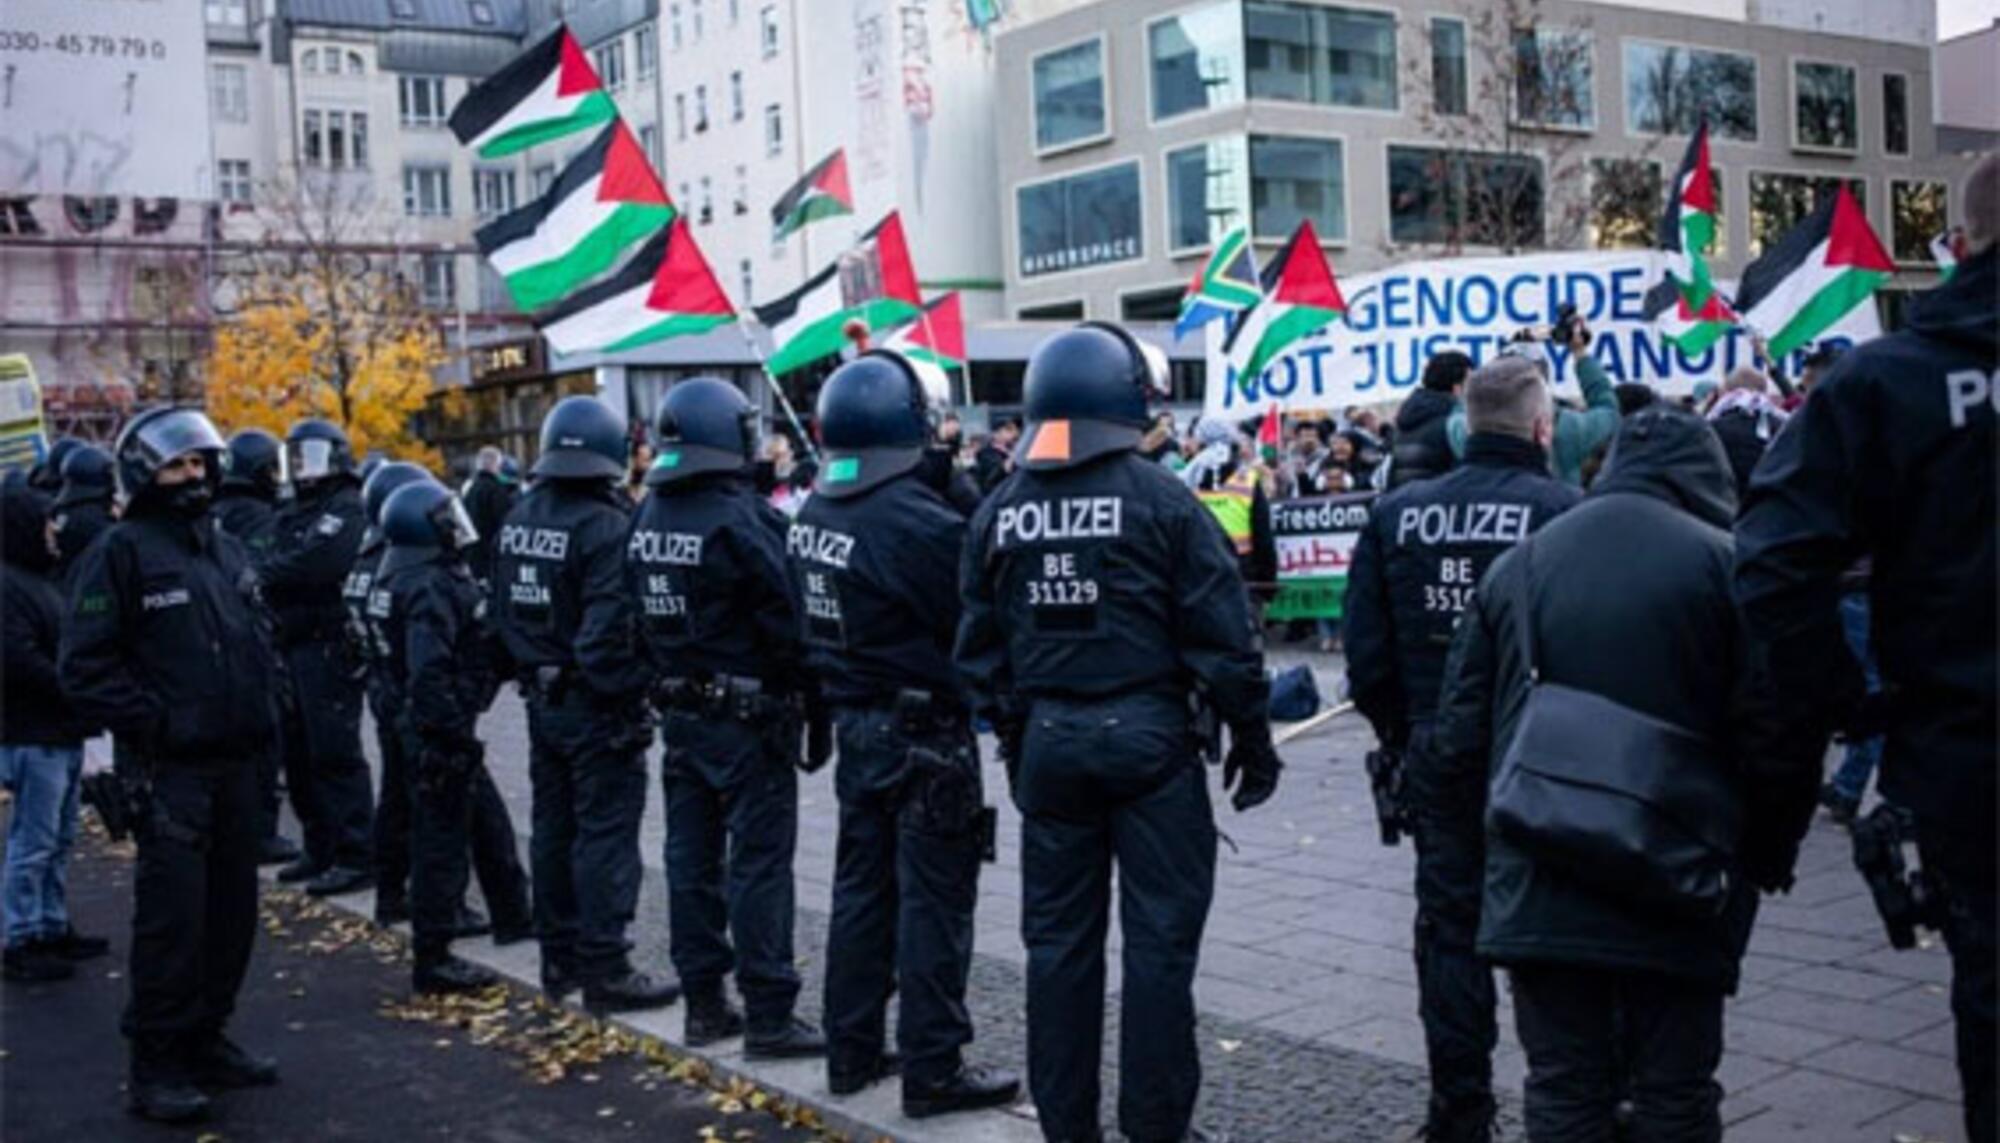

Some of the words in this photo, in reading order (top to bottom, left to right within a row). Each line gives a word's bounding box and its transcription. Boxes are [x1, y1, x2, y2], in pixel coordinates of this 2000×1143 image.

[1343, 269, 1643, 332] GENOCIDE
[997, 496, 1123, 547] POLIZEI
[1269, 501, 1368, 532] Freedom
[1396, 503, 1532, 545] POLIZEI
[500, 524, 568, 560] POLIZEI
[629, 530, 703, 566] POLIZEI
[786, 525, 855, 569] POLIZEI
[1043, 553, 1077, 578] BE
[1440, 557, 1473, 584] BE
[648, 574, 670, 594] BE
[1026, 579, 1099, 605] 31129
